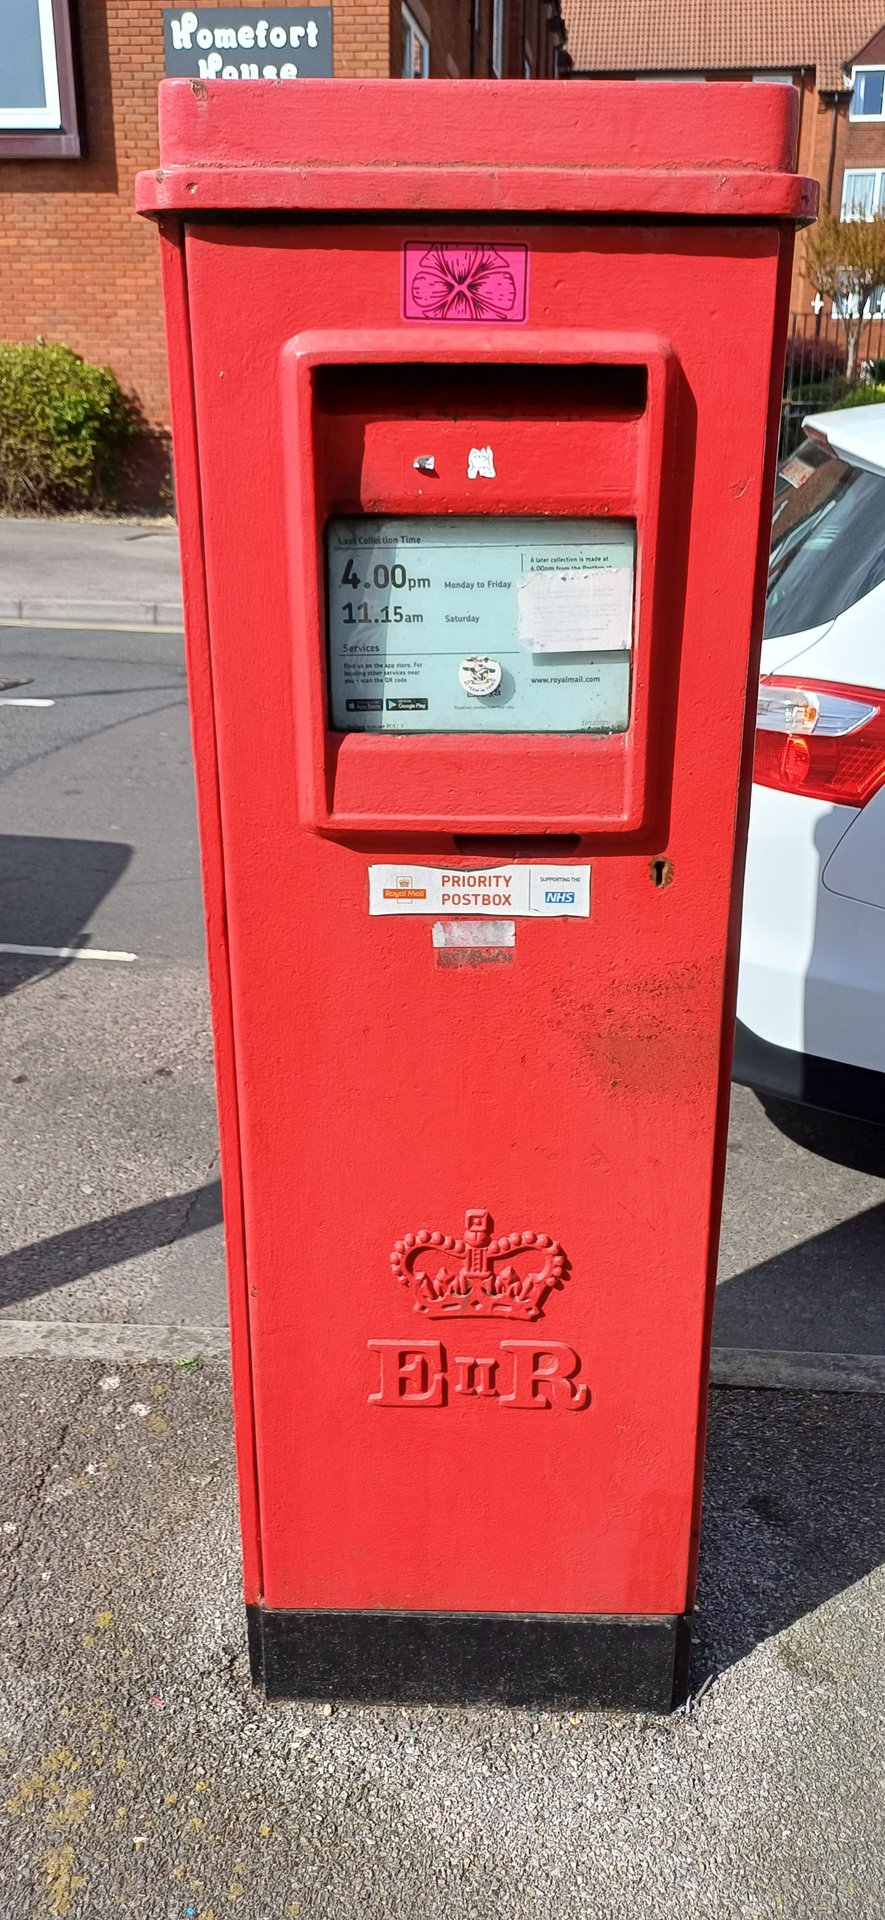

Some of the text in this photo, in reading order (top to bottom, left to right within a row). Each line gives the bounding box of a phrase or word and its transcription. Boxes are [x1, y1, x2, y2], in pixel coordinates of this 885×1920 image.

[171, 12, 318, 49] Homefort
[198, 53, 298, 79] House
[359, 536, 398, 544] Collection
[400, 535, 421, 544] Time
[341, 559, 430, 591] 4.00pm
[444, 581, 474, 589] Monday
[487, 580, 511, 589] Friday
[342, 602, 423, 624] 11.15am
[445, 615, 480, 623] Saturday
[343, 644, 380, 653] Services
[531, 676, 600, 684] www.royalmail.com
[441, 875, 512, 887] PRIORITY
[385, 890, 406, 898] Royal
[441, 893, 512, 906] POSTBOX
[546, 892, 574, 903] NHS
